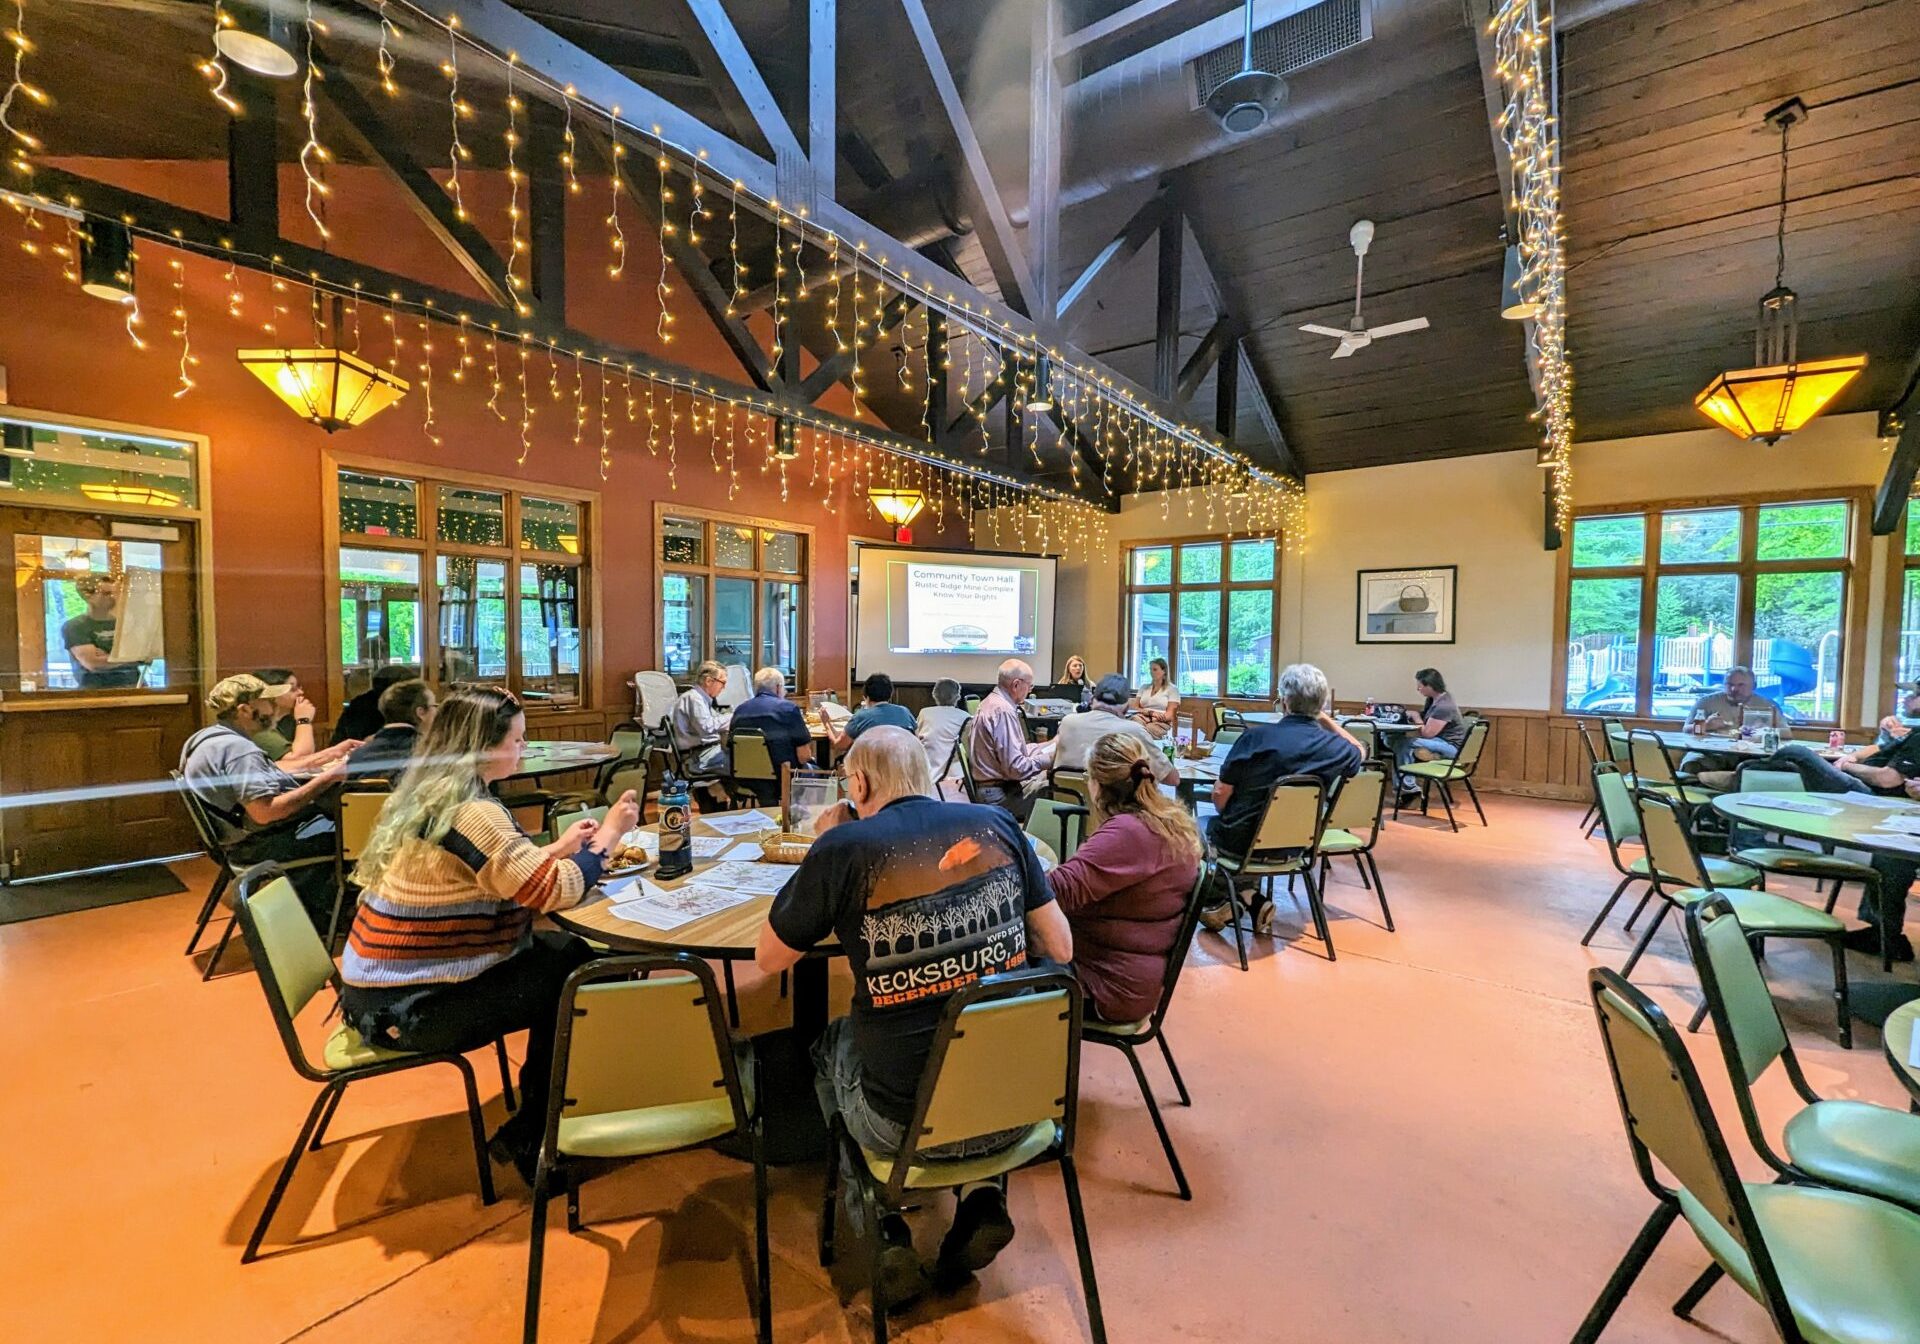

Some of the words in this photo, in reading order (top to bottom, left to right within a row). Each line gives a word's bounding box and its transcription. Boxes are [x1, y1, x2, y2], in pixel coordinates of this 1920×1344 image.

[913, 570, 968, 582] Community
[971, 573, 994, 582] Town
[915, 581, 938, 589] Rustic
[940, 582, 962, 591] Ridge
[983, 585, 1014, 593] Complex
[974, 593, 998, 601] Rights
[987, 930, 1007, 944] KVFD
[866, 942, 1011, 995] KECKSBURG,
[872, 971, 978, 1006] DECEMBER
